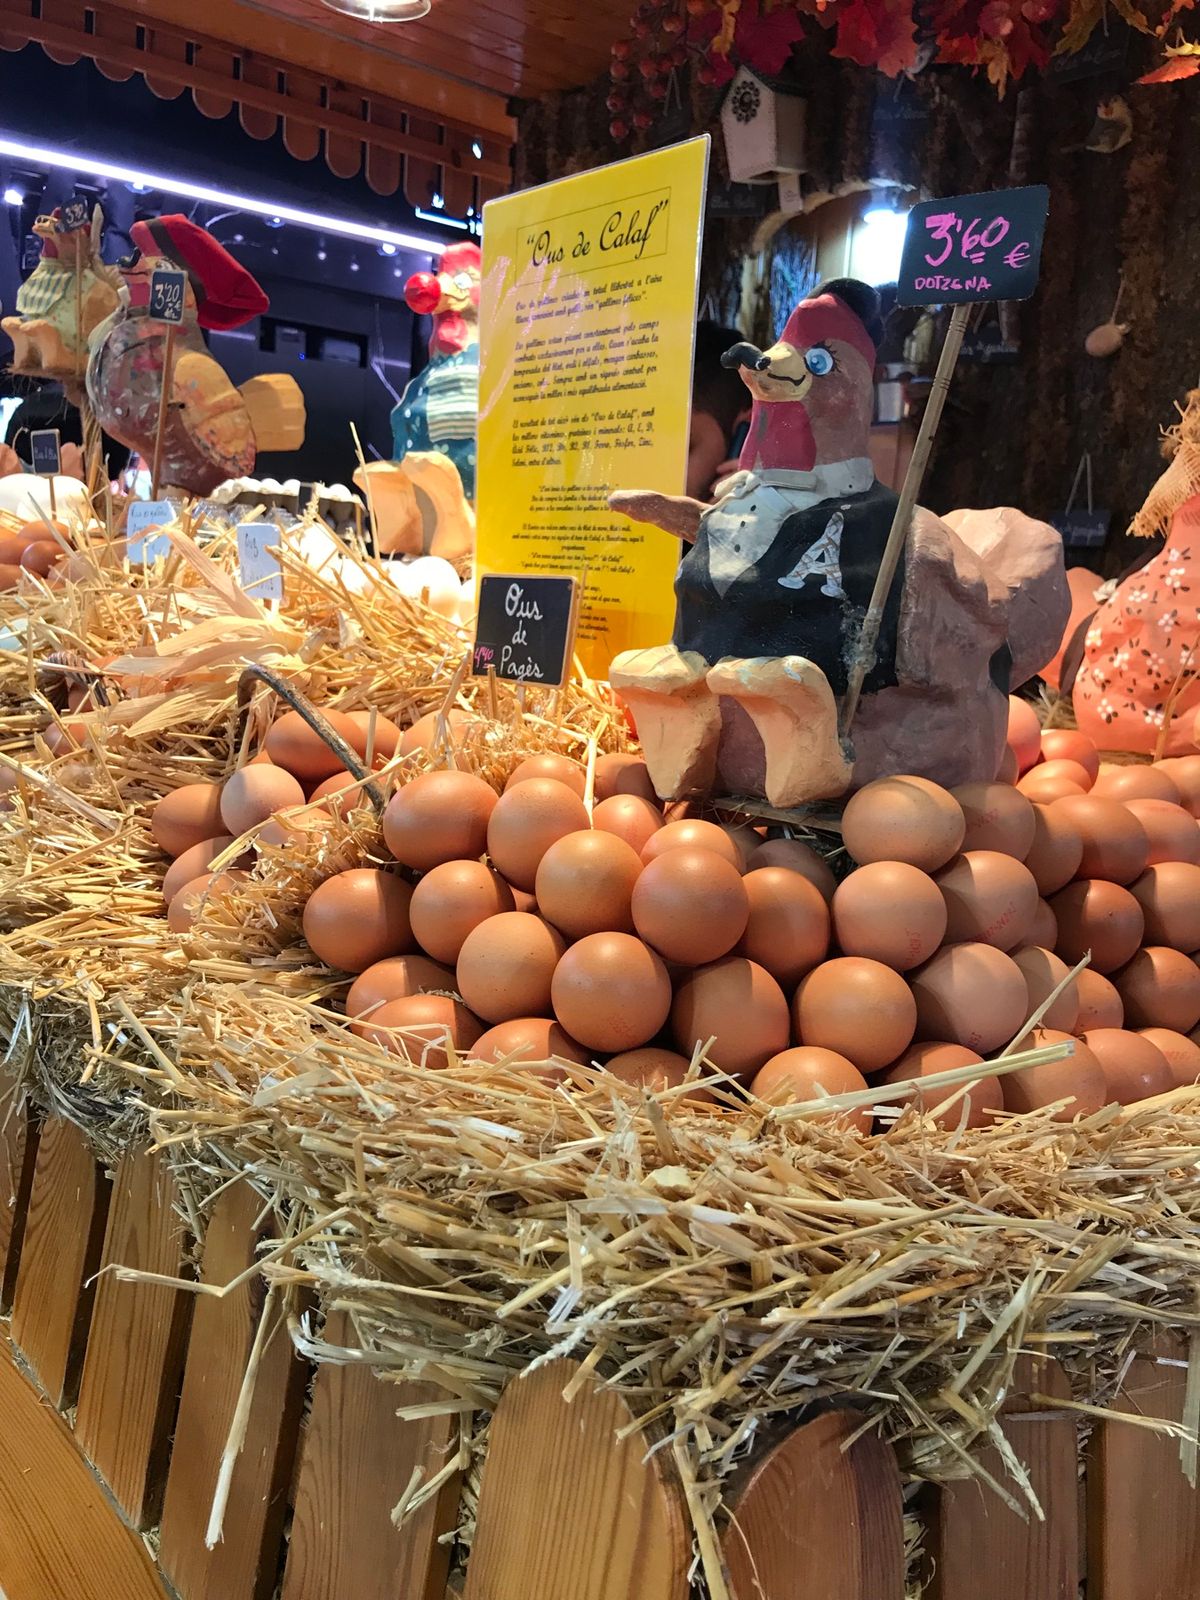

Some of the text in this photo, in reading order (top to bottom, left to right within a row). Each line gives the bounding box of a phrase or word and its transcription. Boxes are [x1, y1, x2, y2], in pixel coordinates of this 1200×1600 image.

[527, 230, 565, 267] "Ous
[572, 231, 591, 257] de
[599, 199, 670, 259] Calaf"
[925, 212, 1030, 268] 3'60 €
[915, 275, 991, 292] DOTZENA
[505, 583, 543, 620] Ous
[511, 621, 528, 646] de
[500, 645, 544, 681] Pagès
